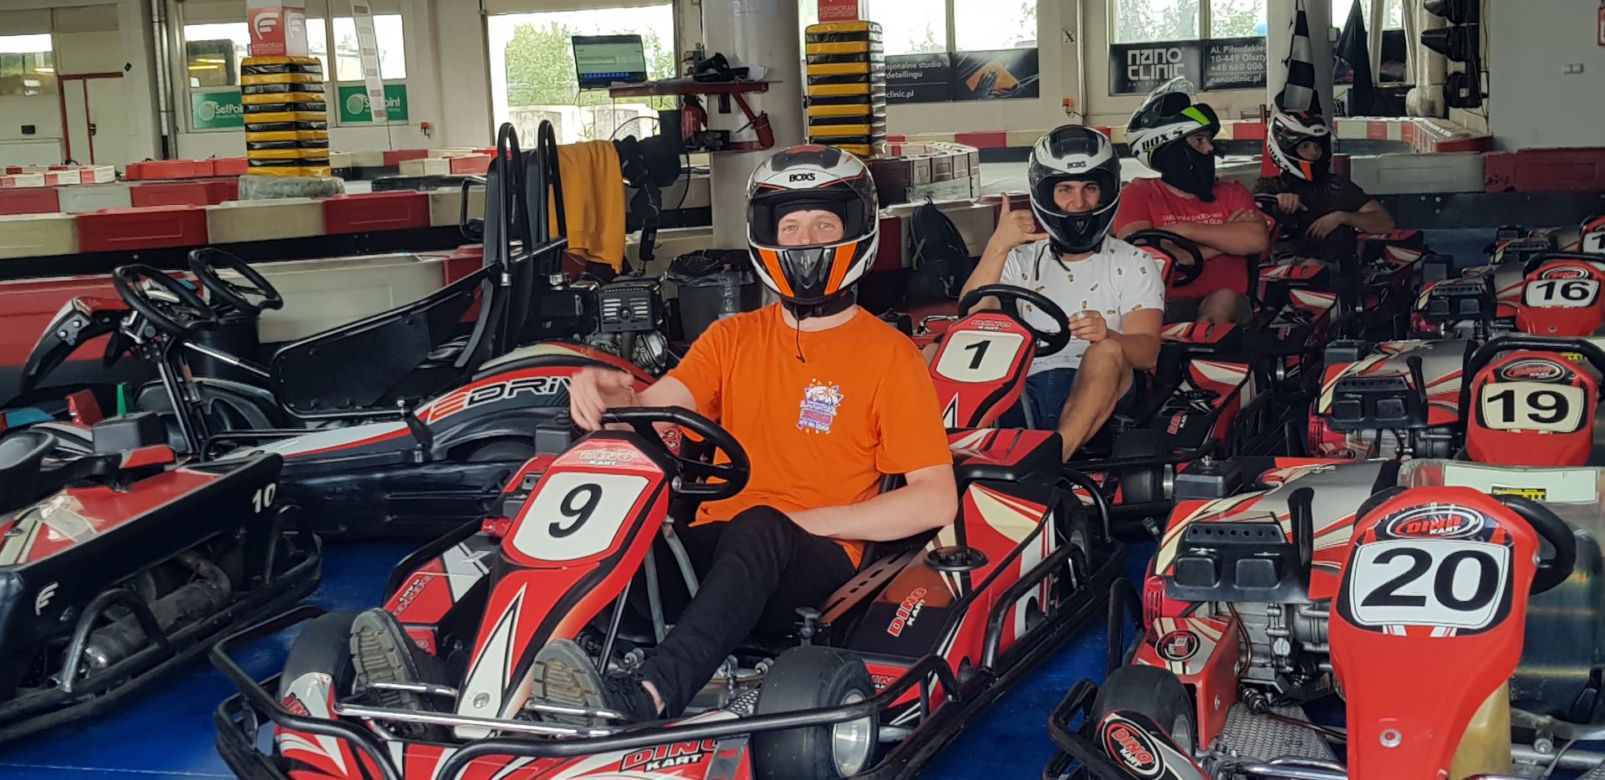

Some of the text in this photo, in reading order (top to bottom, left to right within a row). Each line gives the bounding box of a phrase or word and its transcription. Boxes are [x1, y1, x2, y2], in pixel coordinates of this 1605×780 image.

[919, 60, 941, 68] studio
[1211, 54, 1240, 62] 10-449
[1247, 62, 1263, 70] 006
[886, 71, 923, 79] detailingu
[1210, 74, 1261, 84] nanoclinic.pl
[215, 104, 244, 114] SetPoi
[789, 173, 816, 182] BOXS
[1536, 281, 1590, 301] 16
[965, 340, 991, 369] 1
[1487, 389, 1569, 423] 19
[251, 483, 277, 513] 10
[548, 483, 603, 539] 9
[1405, 516, 1462, 533] DINO
[1360, 547, 1500, 611] 20
[887, 587, 927, 637] DINO
[1111, 728, 1156, 765] DINO
[645, 753, 701, 772] KART
